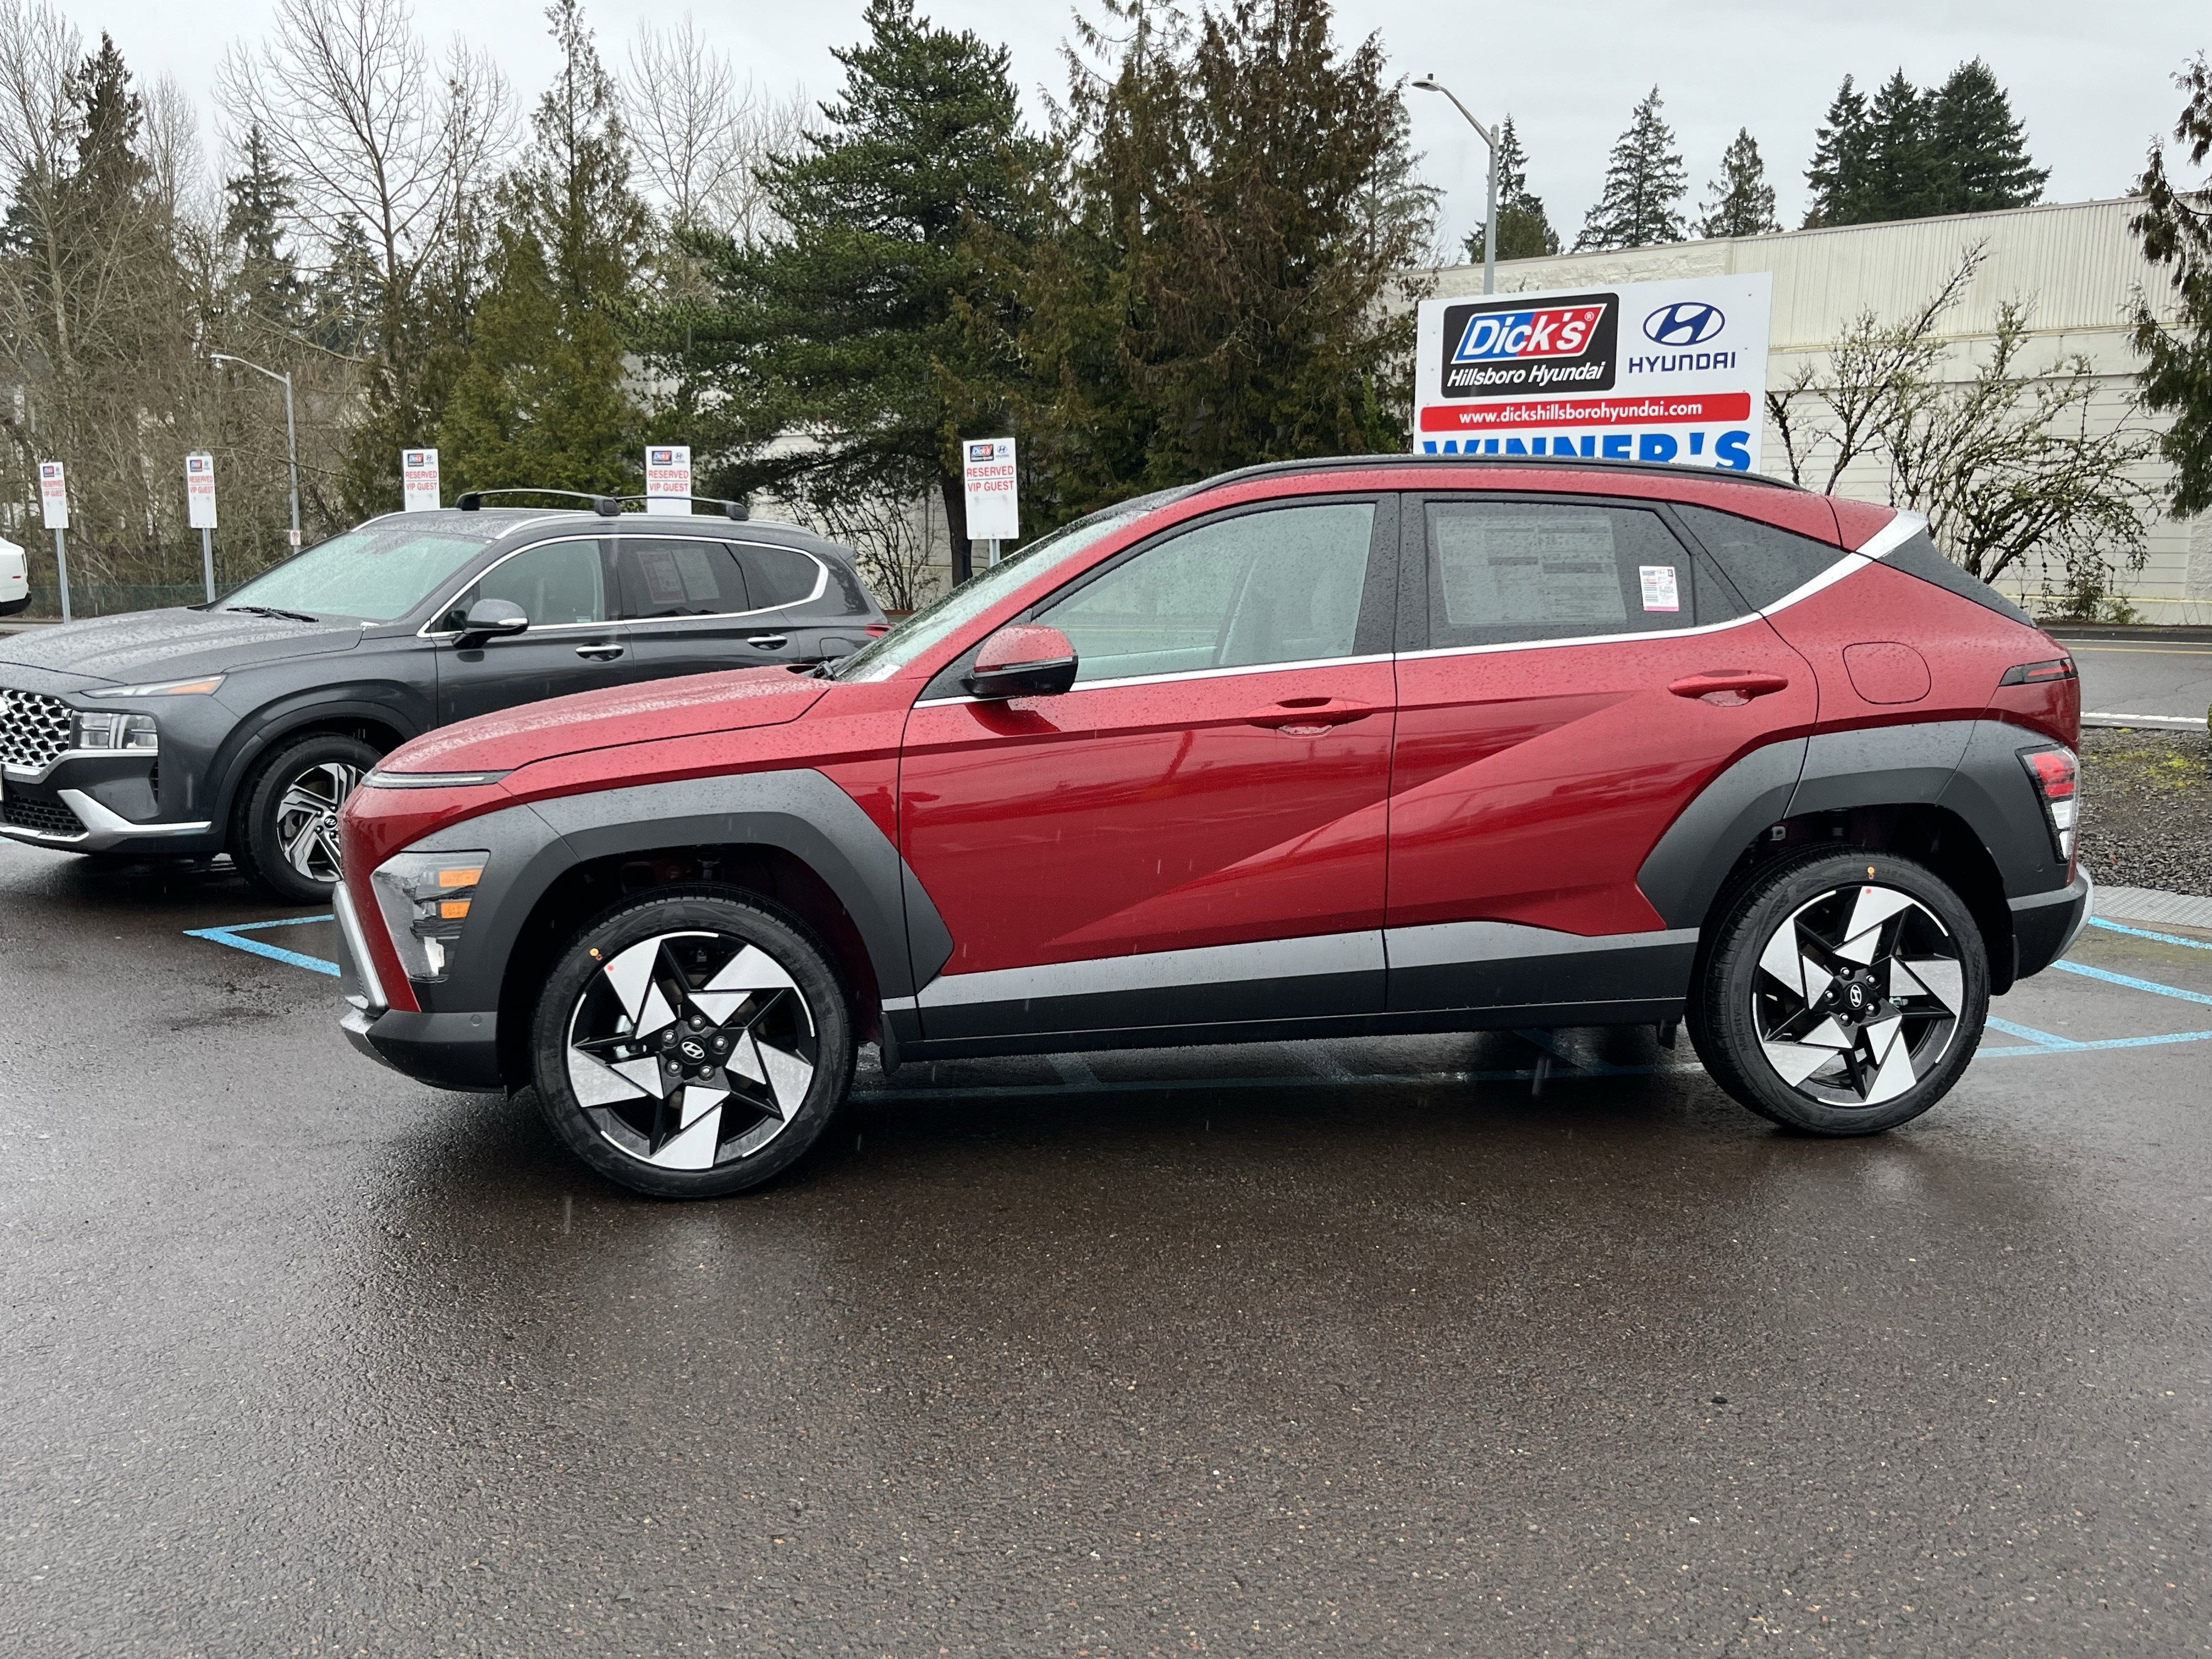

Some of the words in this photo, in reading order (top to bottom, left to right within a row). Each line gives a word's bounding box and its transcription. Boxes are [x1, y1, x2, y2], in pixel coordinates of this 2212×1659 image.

[1628, 351, 1736, 374] HYUNDAI
[1447, 367, 1526, 387] Hillsboro
[1528, 361, 1606, 387] Hyundai
[1459, 400, 1702, 424] www.dickshillsborohyundai.com
[1422, 430, 1751, 472] ER'S
[405, 471, 437, 479] RESERVED
[648, 470, 689, 479] RESERVED
[967, 466, 1014, 477] RESERVED
[417, 482, 437, 490] GUEST
[649, 483, 661, 491] VIP
[663, 483, 689, 492] GUEST
[967, 483, 981, 492] VIP
[984, 481, 1014, 492] GUEST
